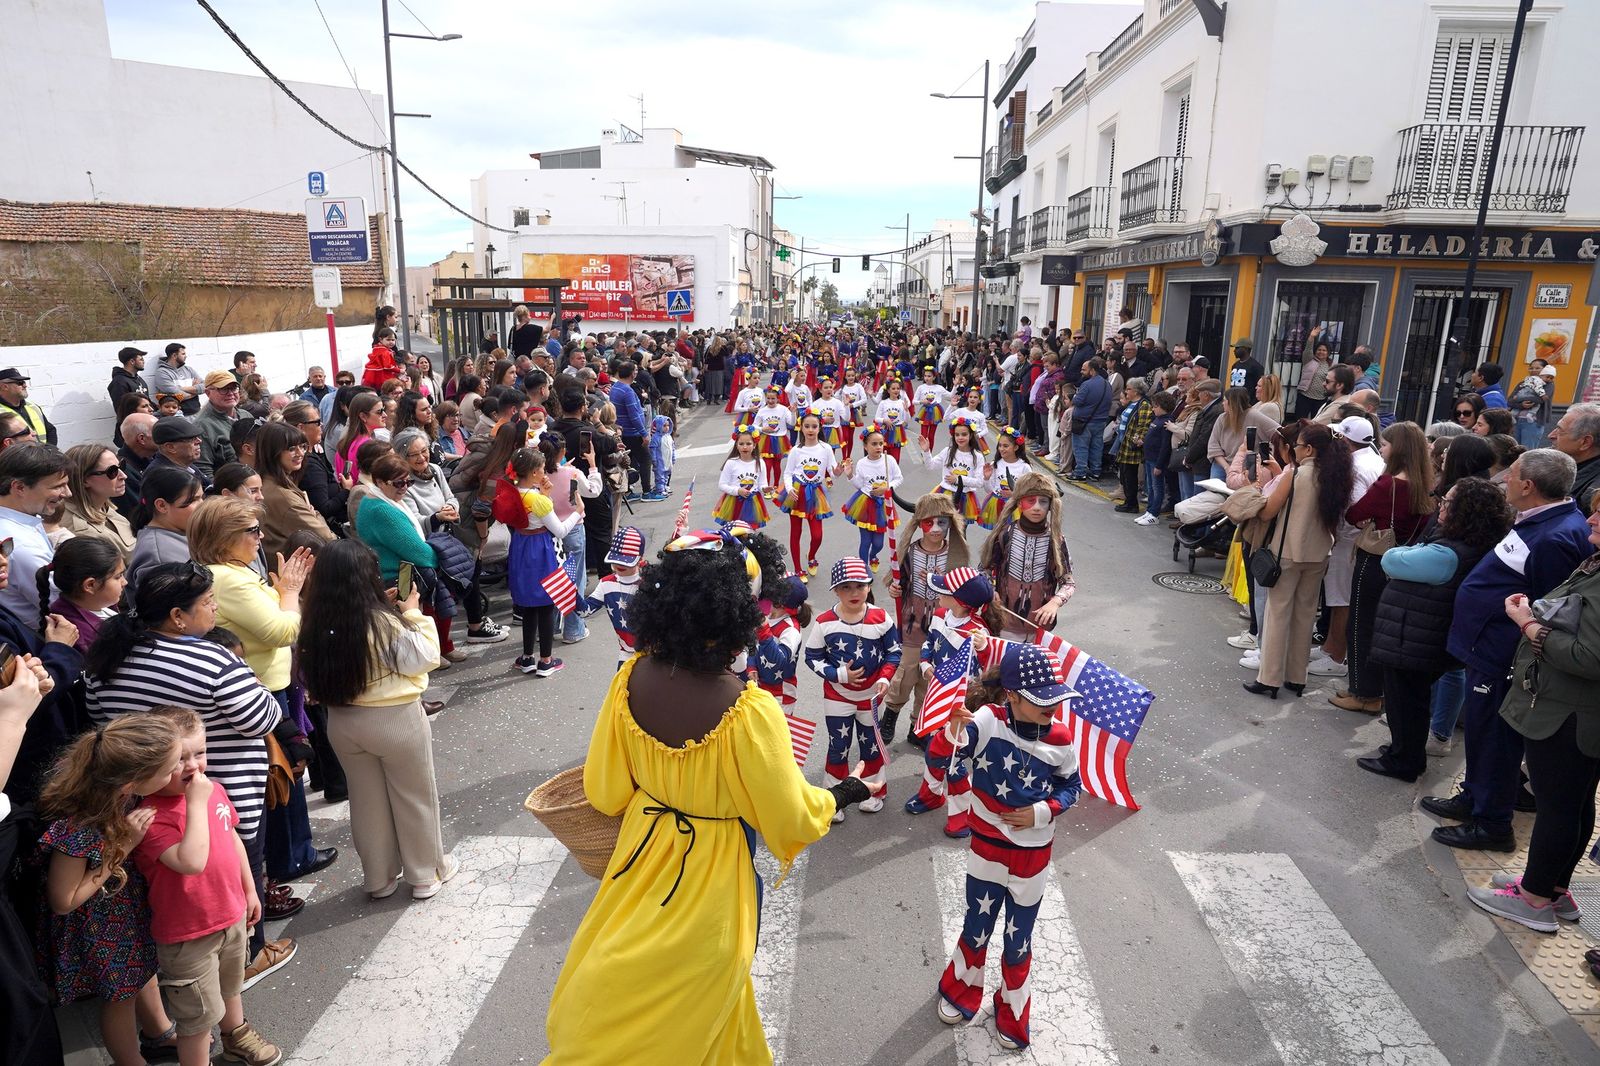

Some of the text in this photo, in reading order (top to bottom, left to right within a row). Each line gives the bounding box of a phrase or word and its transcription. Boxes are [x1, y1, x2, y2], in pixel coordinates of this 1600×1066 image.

[1137, 235, 1199, 263] CAFETERÍA
[1347, 232, 1600, 259] HELADERÍA &
[581, 264, 611, 274] am3
[581, 280, 633, 292] ALQUILER
[808, 457, 822, 466] AMO
[958, 461, 971, 471] AMO
[745, 472, 758, 480] AMO
[868, 477, 875, 485] TE
